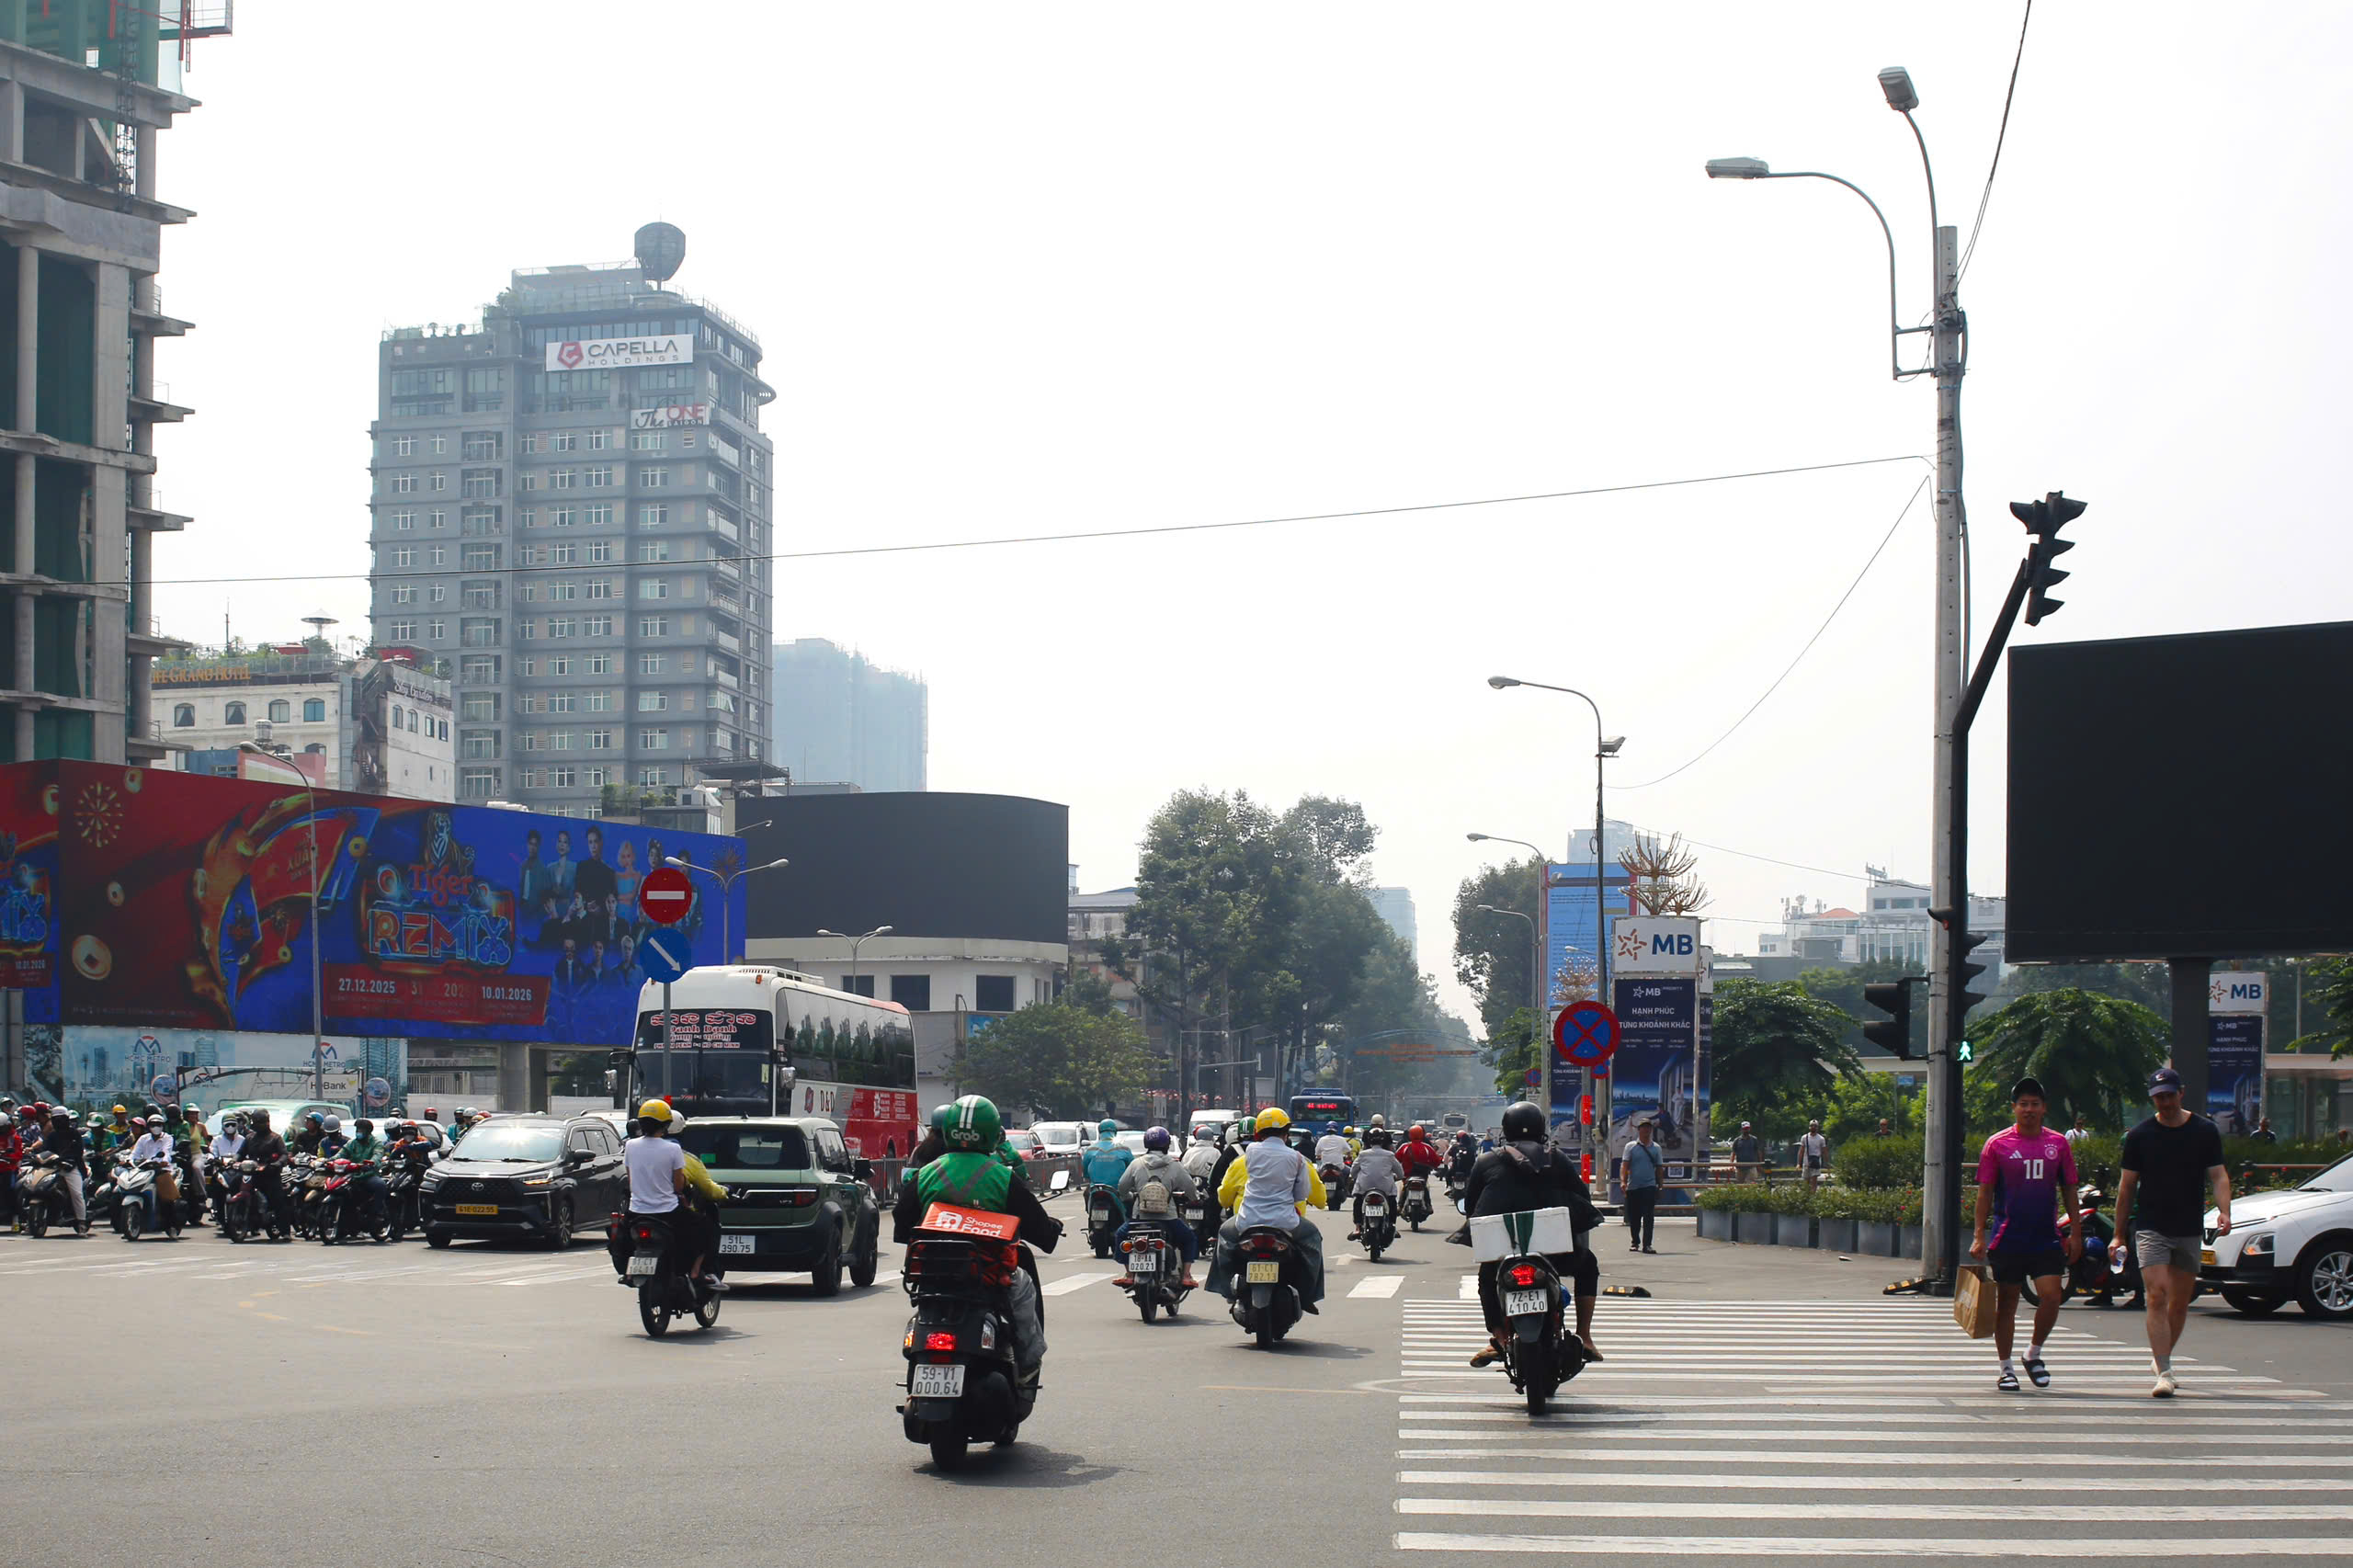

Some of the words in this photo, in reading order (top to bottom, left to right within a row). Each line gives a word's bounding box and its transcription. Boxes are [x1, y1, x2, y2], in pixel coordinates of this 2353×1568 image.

[588, 339, 678, 358] CAPELLA
[588, 355, 679, 366] HOLDINGS
[169, 666, 213, 683] GRAND
[216, 664, 251, 681] HOTEL
[410, 684, 434, 702] Garden
[408, 863, 474, 907] Tiger
[369, 909, 512, 965] REMIX
[1652, 933, 1693, 956] MB
[338, 978, 396, 994] 27.12.2025
[482, 985, 532, 1001] 10.01.2026
[1645, 987, 1662, 996] MB
[2230, 983, 2262, 1000] MB
[1631, 1007, 1654, 1017] HẠNH
[1654, 1006, 1675, 1015] PHÚC
[311, 1081, 347, 1090] HBank
[820, 1090, 835, 1112] D&D
[950, 1129, 981, 1142] Grab
[2023, 1158, 2044, 1179] 10
[961, 1223, 1002, 1237] Food
[965, 1216, 1004, 1230] Shopee
[729, 1235, 745, 1244] 51L
[722, 1244, 751, 1253] 390.75
[1512, 1290, 1540, 1303] 72-E1
[1508, 1301, 1545, 1315] 410.40
[921, 1367, 956, 1380] 59-V1
[915, 1381, 959, 1395] 000.64
